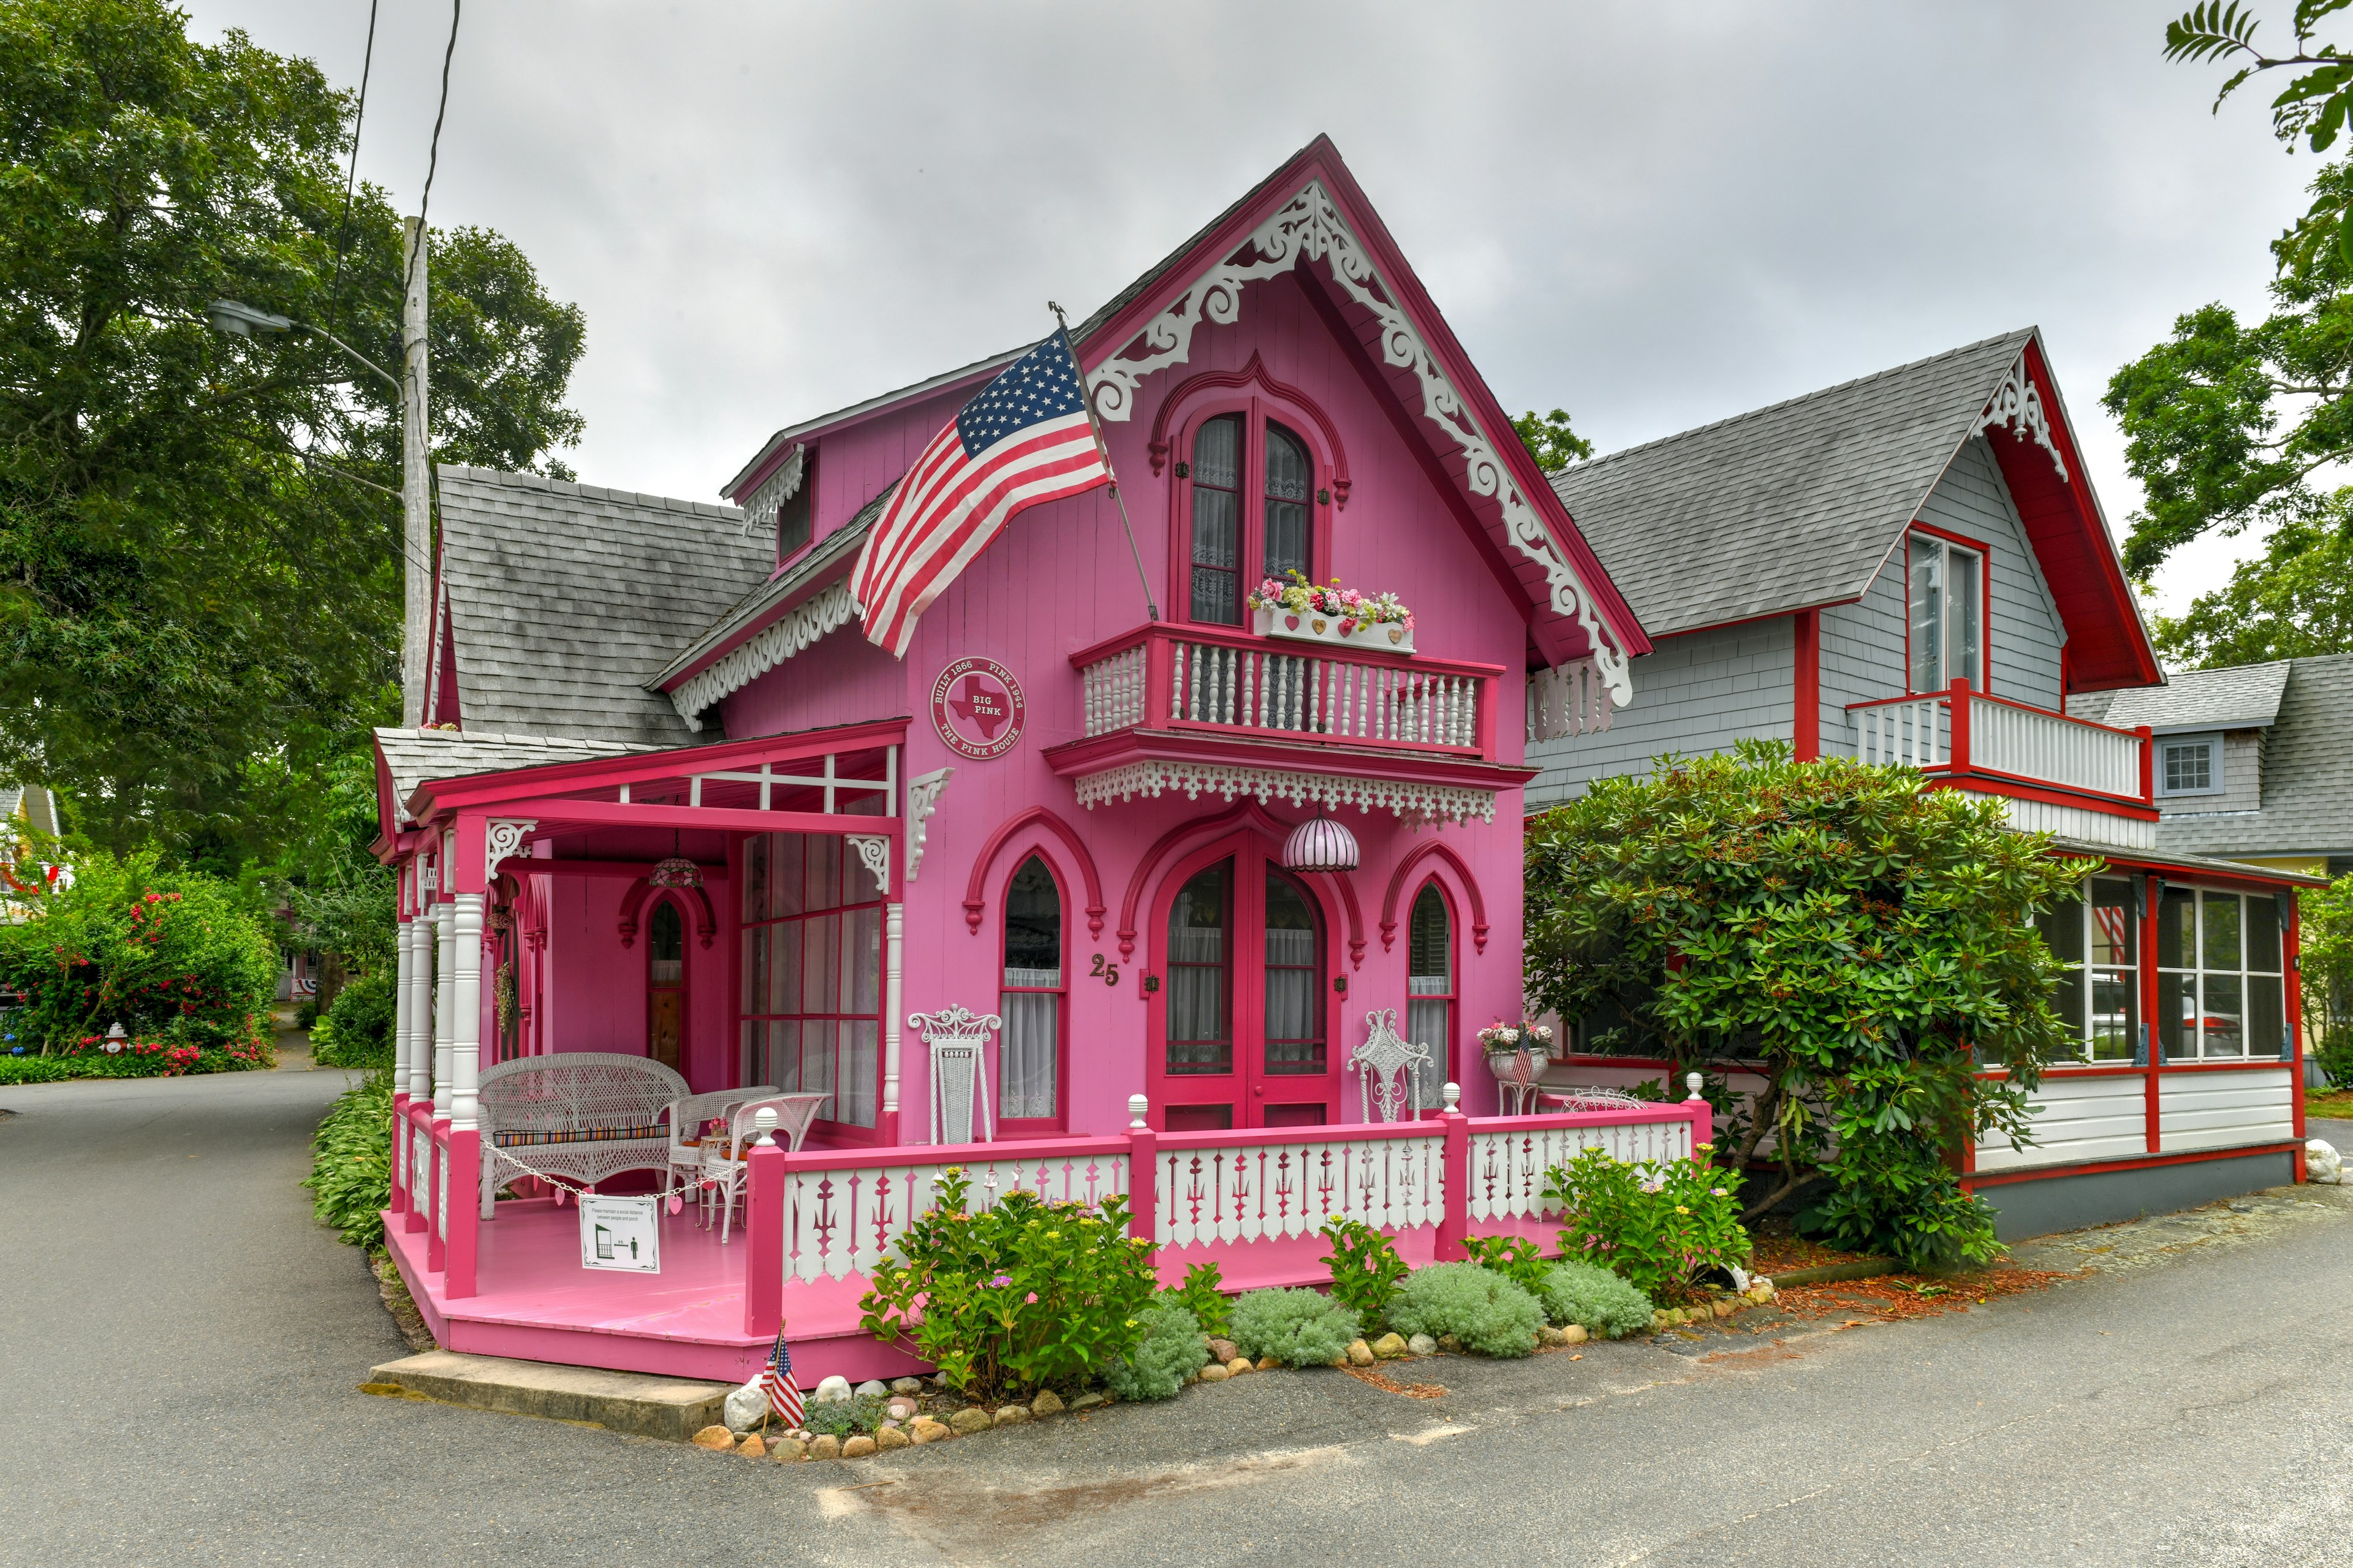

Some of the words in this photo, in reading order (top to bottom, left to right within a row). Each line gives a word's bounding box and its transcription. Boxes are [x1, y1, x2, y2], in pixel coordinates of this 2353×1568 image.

[935, 673, 951, 704] BUILT
[950, 661, 973, 676] 1866
[988, 663, 1012, 684] PINK
[1009, 684, 1023, 709] 1944
[972, 695, 992, 705] BIG
[975, 705, 1001, 716] PINK
[941, 723, 958, 744] THE
[961, 743, 988, 756] PINK
[992, 727, 1020, 754] HOUSE
[1089, 953, 1119, 987] 25
